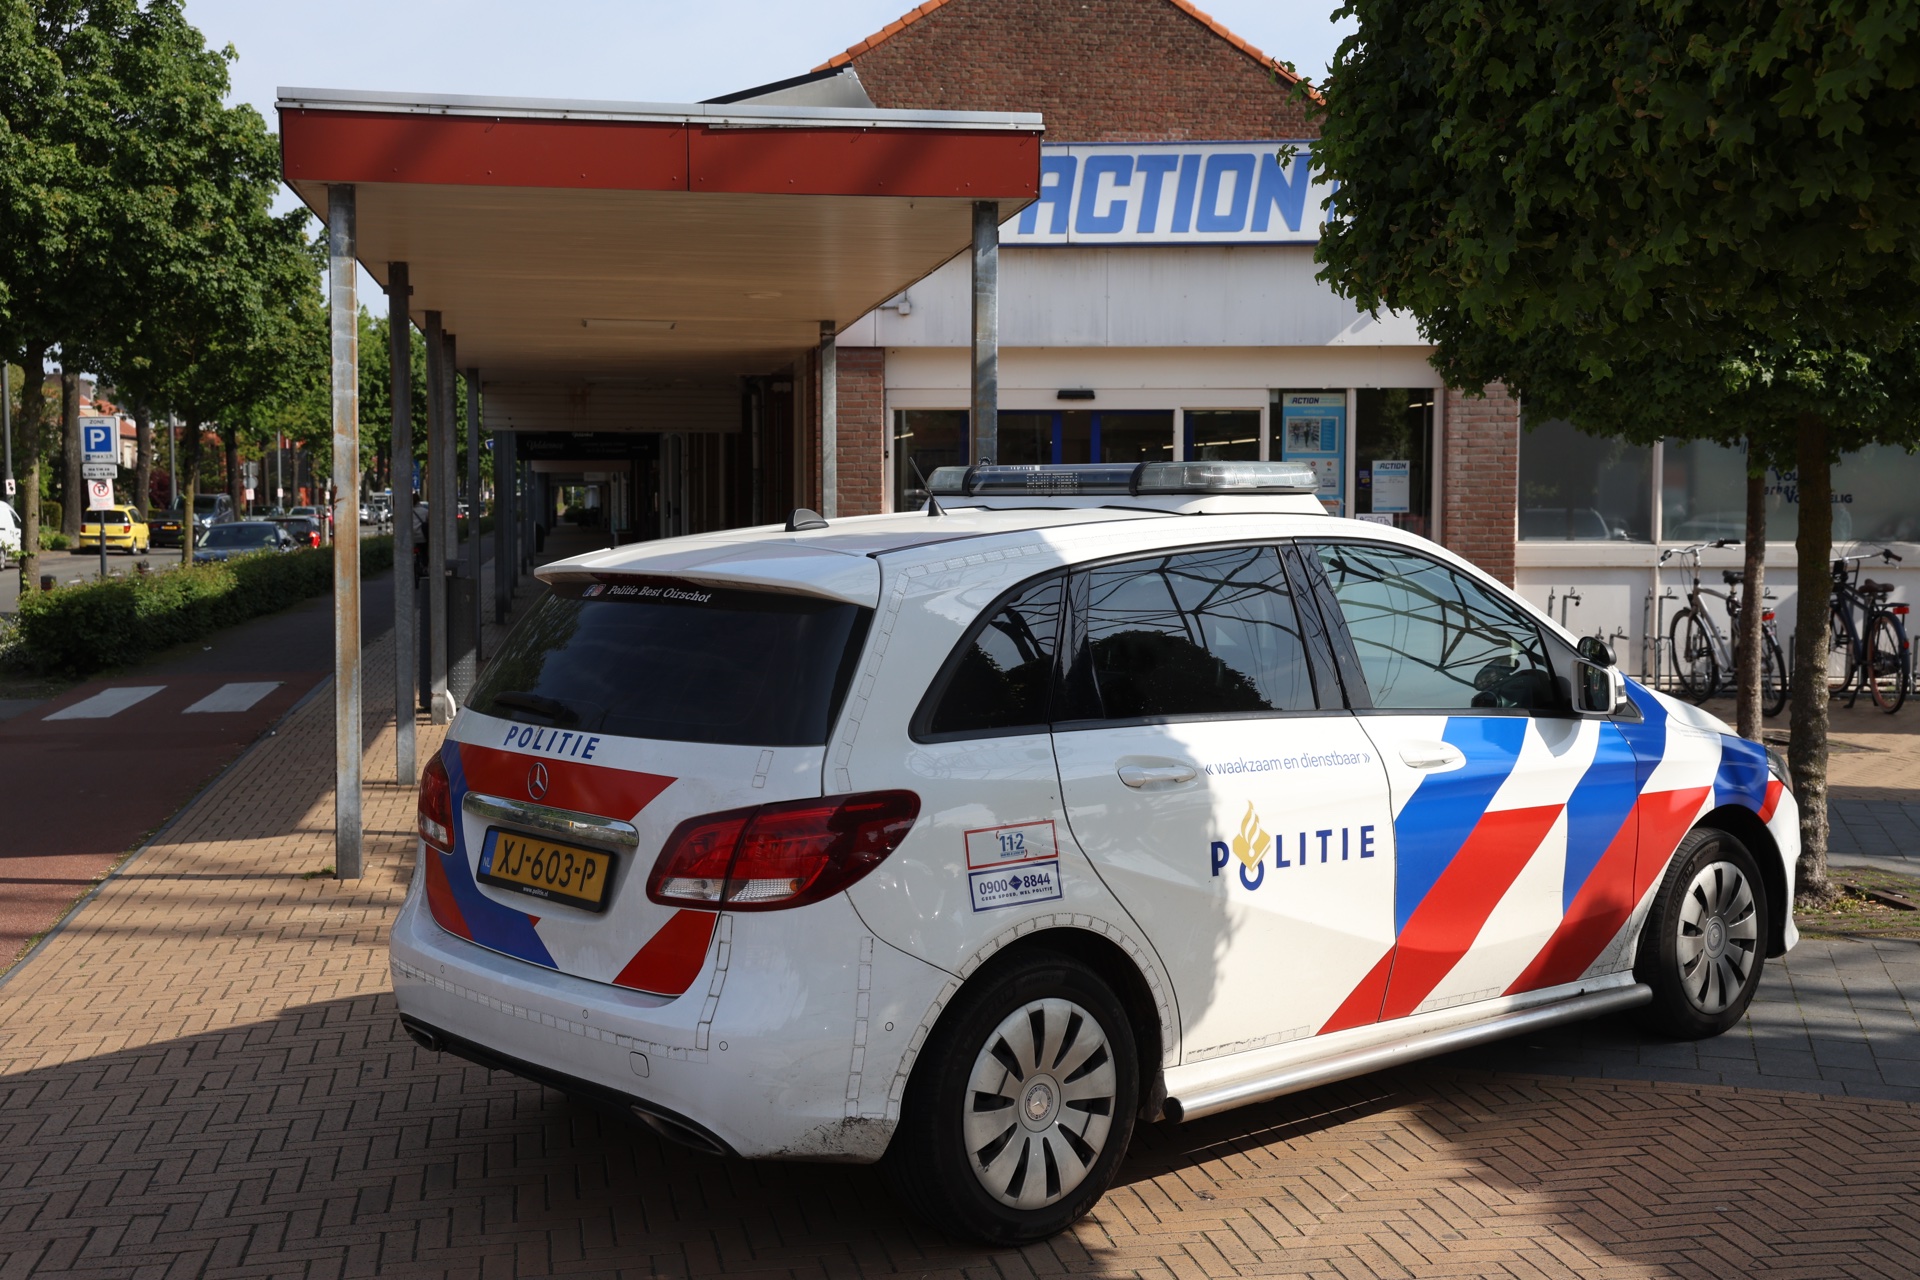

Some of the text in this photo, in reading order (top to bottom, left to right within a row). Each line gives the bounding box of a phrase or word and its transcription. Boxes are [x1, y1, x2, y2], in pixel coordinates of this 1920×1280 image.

[1018, 153, 1311, 235] ACTION
[1292, 397, 1320, 405] ACTION
[89, 428, 106, 450] P
[1380, 462, 1407, 470] ACTION
[607, 585, 711, 603] Politie Best Oirschot
[503, 725, 600, 760] POLITIE
[1215, 757, 1282, 775] waakzaam
[1283, 758, 1299, 770] en
[1300, 750, 1360, 768] dienstbaar
[483, 856, 491, 868] NL
[498, 839, 596, 892] XJ-603-P
[1210, 825, 1375, 891] POLITIE
[523, 886, 549, 898] www.politie.nl
[979, 873, 1051, 895] 0900 8844
[1032, 886, 1053, 894] POLITIE
